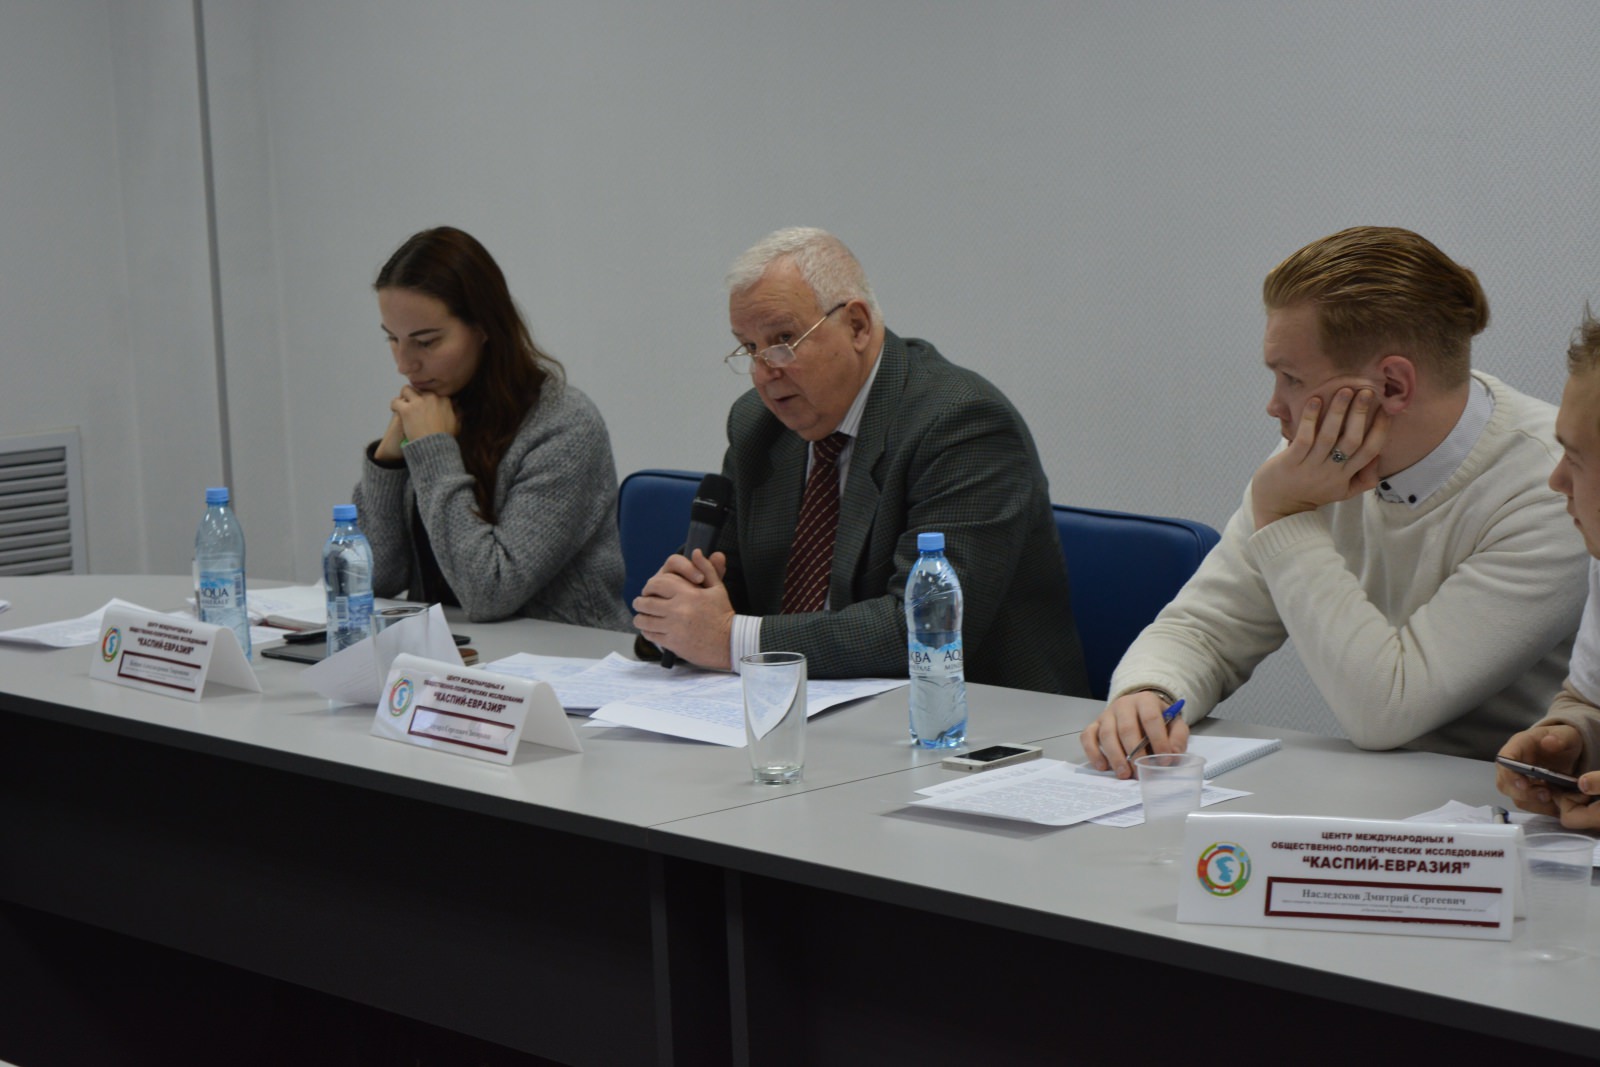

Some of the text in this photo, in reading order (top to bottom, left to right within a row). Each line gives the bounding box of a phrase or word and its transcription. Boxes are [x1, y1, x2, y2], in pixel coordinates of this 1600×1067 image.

[1321, 831, 1454, 844] ЦЕНТР МЕЖДУНАРОДНЫХ И
[1271, 841, 1505, 858] ОБЩЕСТВЕННО-ПОЛИТИЧЕСКИХ ИССЛЕДОВАНИЙ
[1362, 892, 1409, 904] Дмитрий
[1412, 894, 1466, 905] Сергеевич
